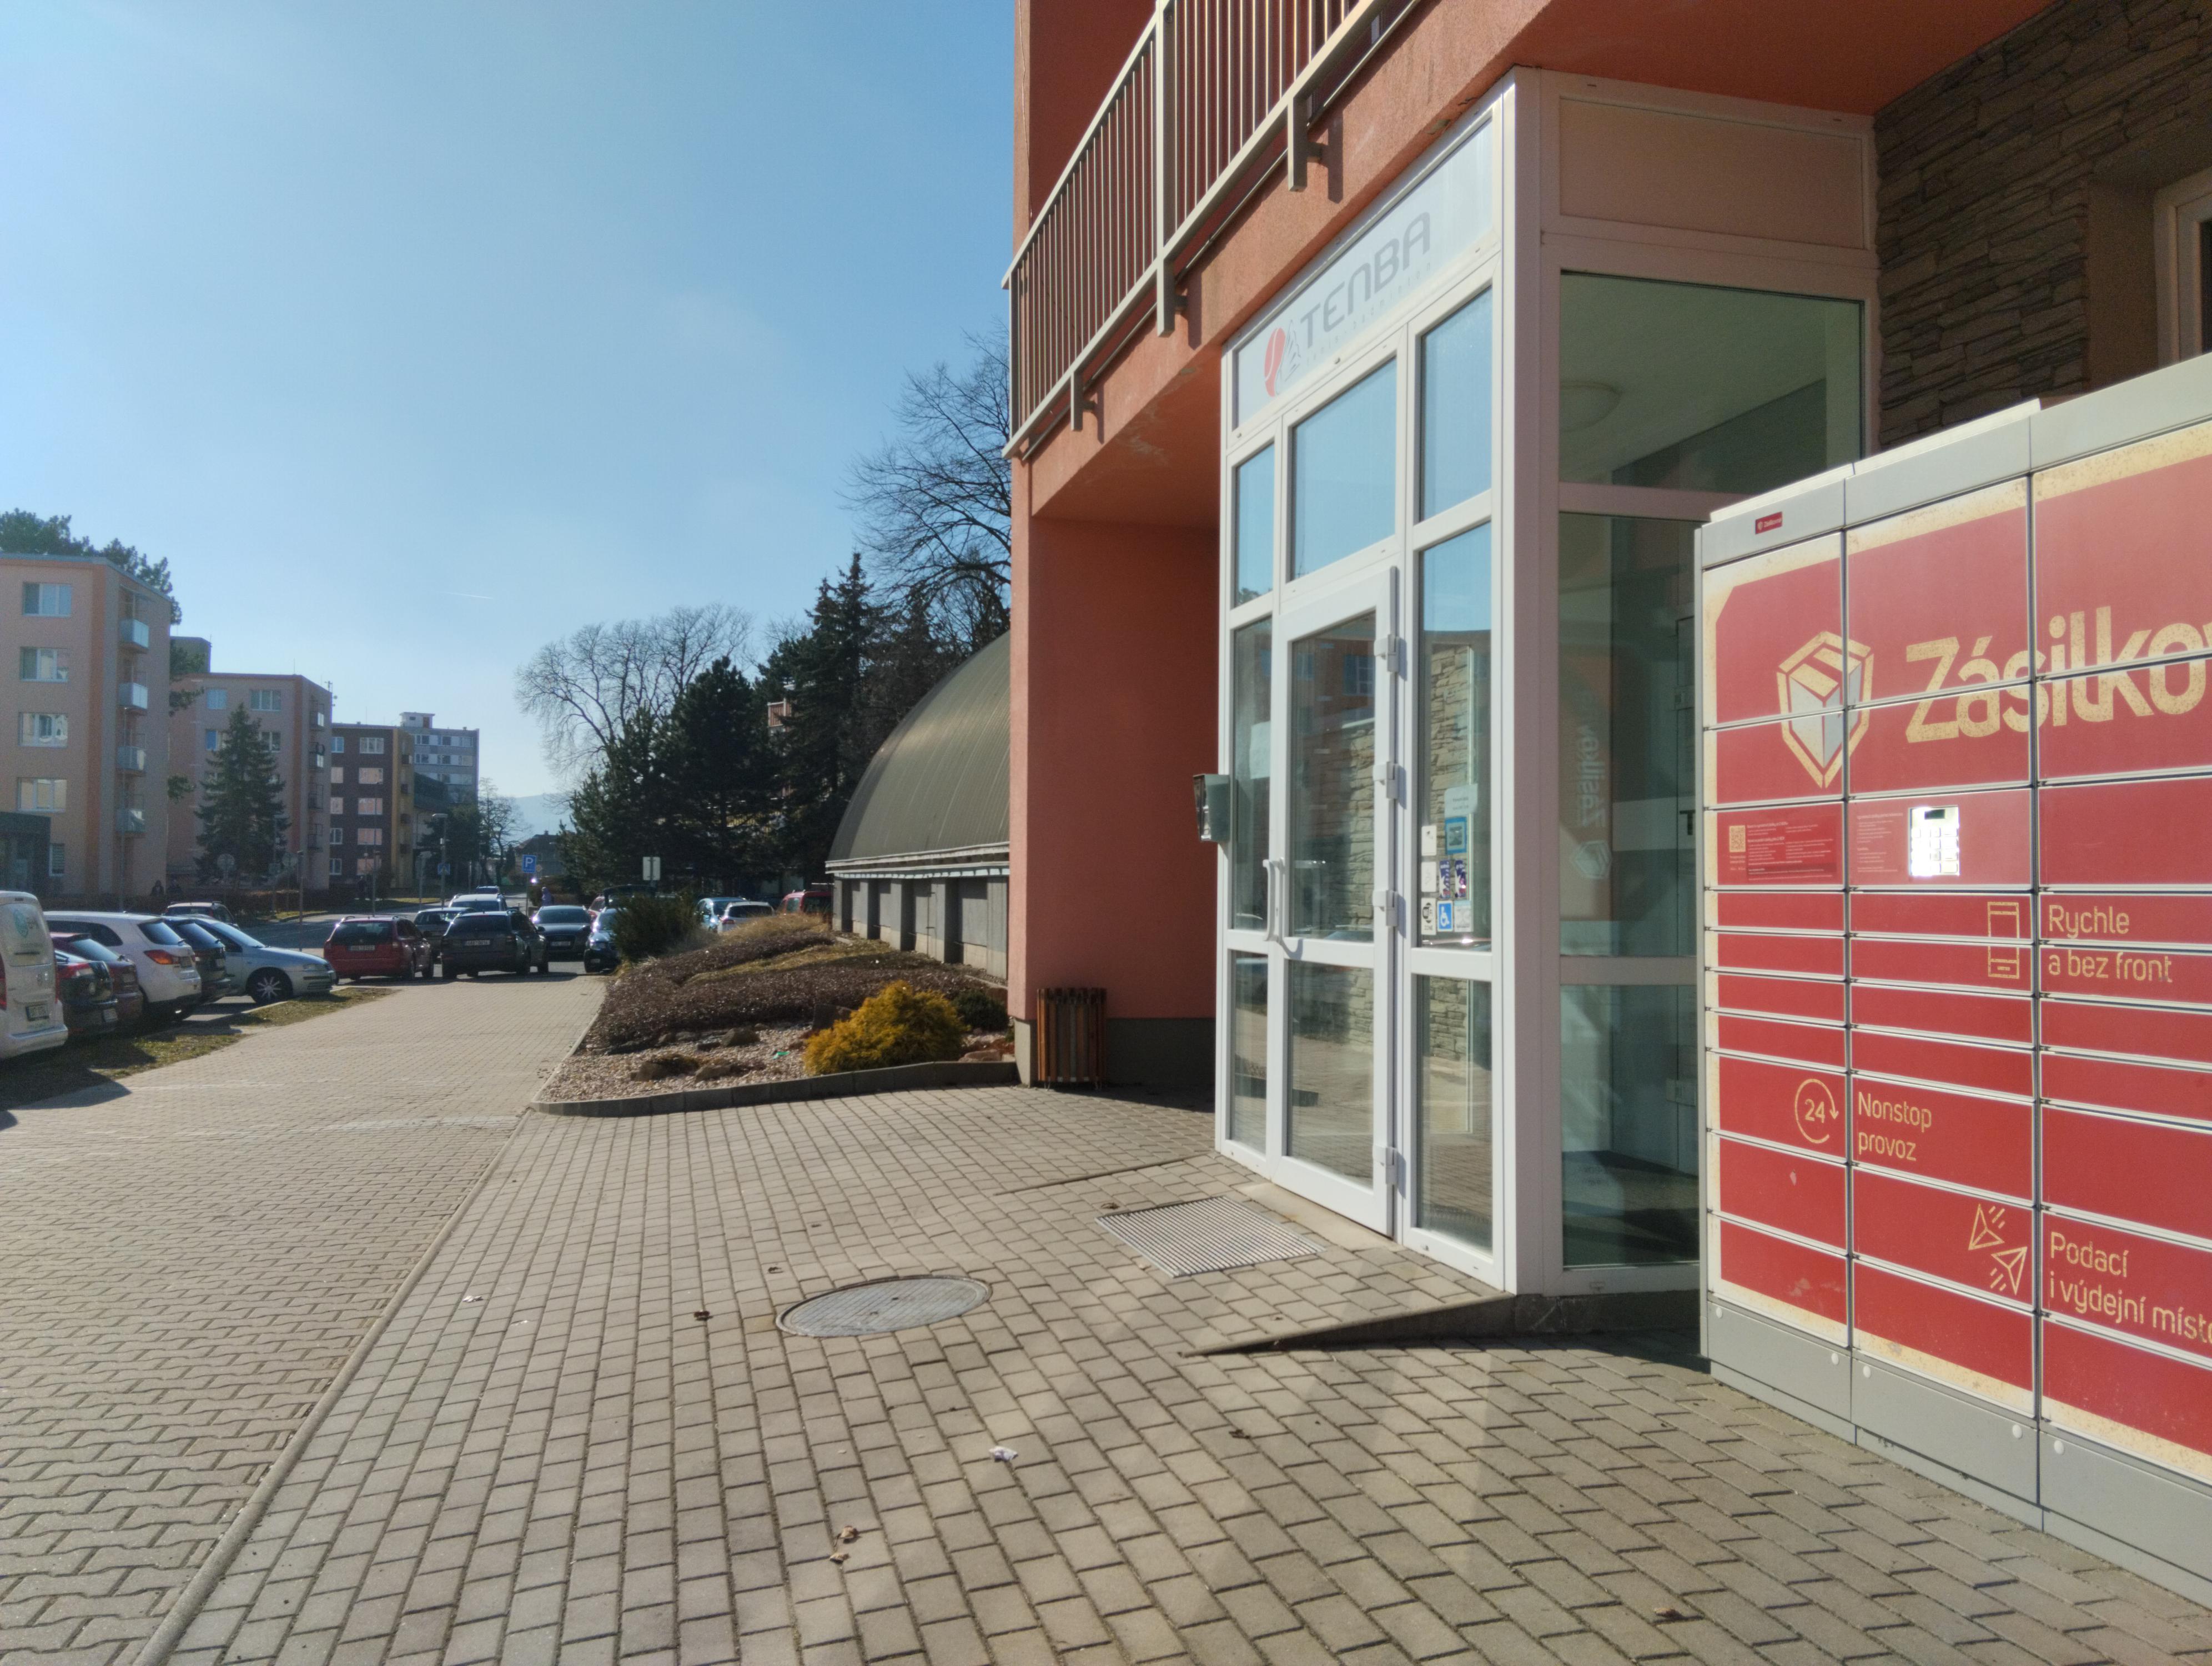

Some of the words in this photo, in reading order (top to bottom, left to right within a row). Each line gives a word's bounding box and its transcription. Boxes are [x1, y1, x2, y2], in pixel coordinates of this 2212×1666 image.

[1906, 606, 2212, 743] Zásilko
[525, 857, 534, 867] P
[2049, 905, 2129, 939] Rychle
[2049, 954, 2061, 976] a
[2068, 949, 2109, 978] bez
[2116, 951, 2173, 982] front
[1804, 1098, 1826, 1123] 24
[1858, 1091, 1932, 1133] Nonstop
[1858, 1132, 1916, 1161] provoz
[2050, 1231, 2129, 1278] Podací
[2050, 1271, 2055, 1298] i
[2060, 1279, 2146, 1324] výdejní
